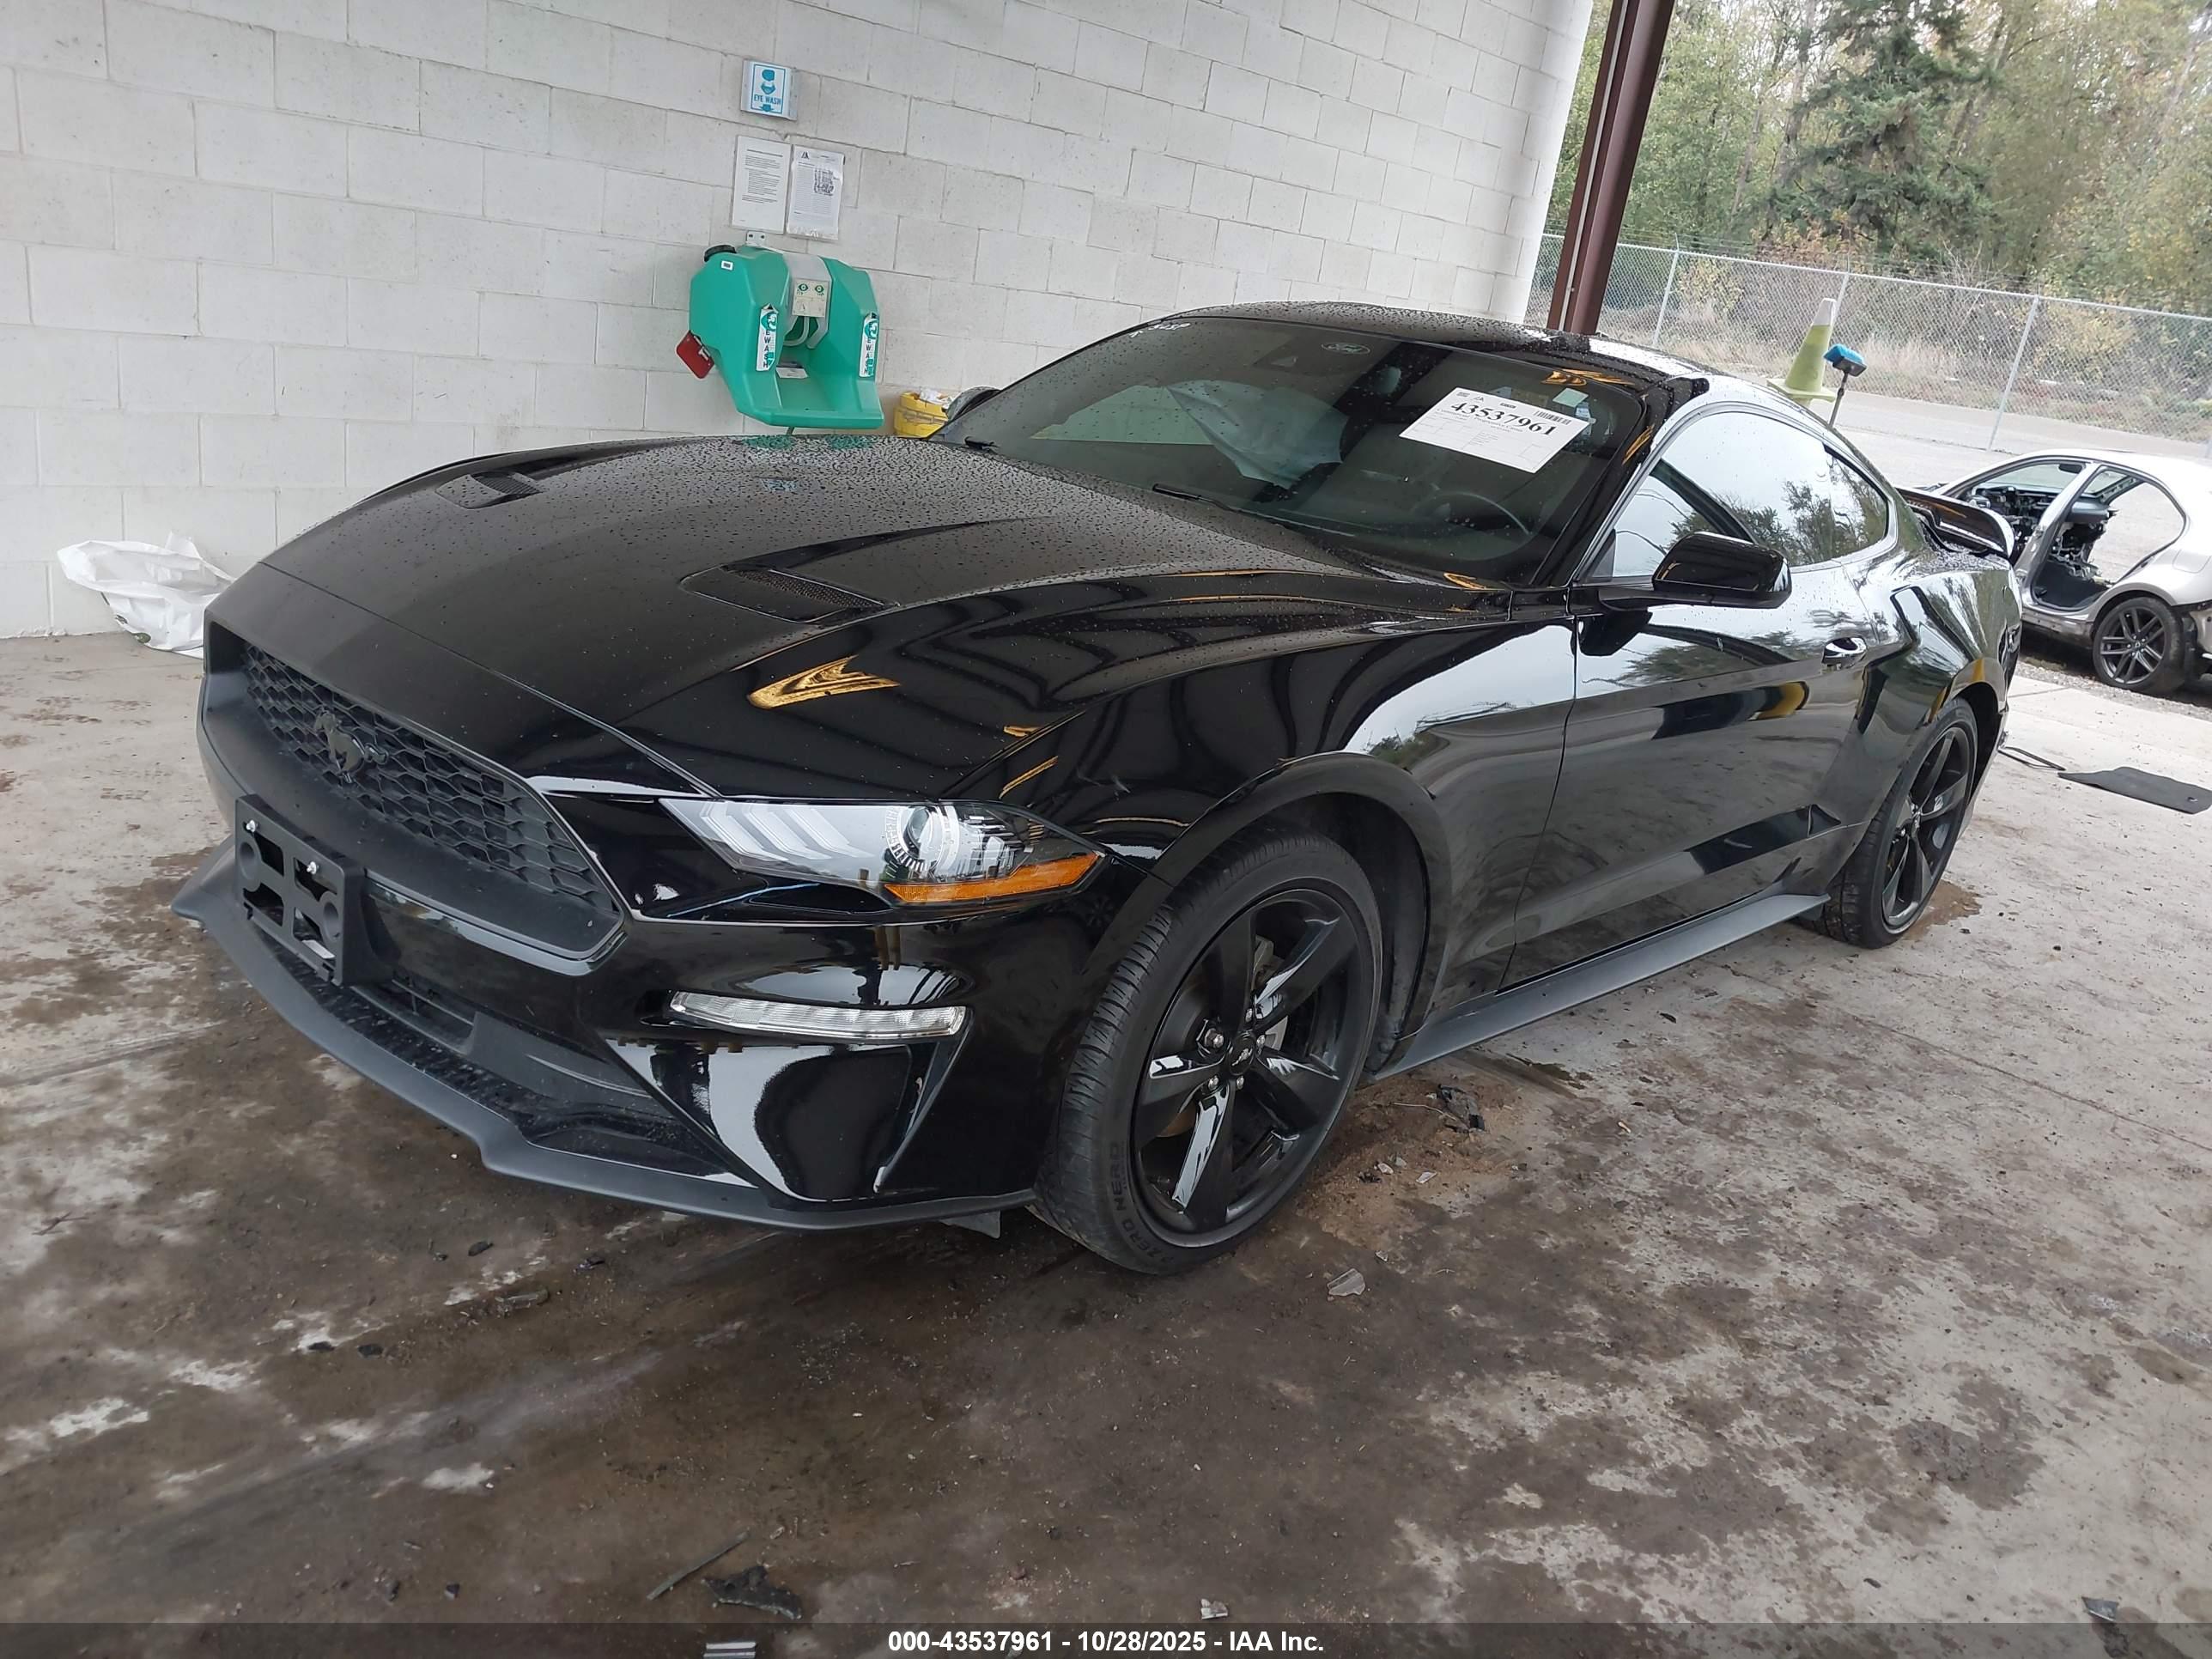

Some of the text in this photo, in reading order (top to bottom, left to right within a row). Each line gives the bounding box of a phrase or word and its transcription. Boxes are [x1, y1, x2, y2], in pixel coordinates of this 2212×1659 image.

[754, 94, 781, 105] EYE WASH
[1451, 402, 1557, 436] 43537961
[1109, 1141, 1127, 1211] NERO
